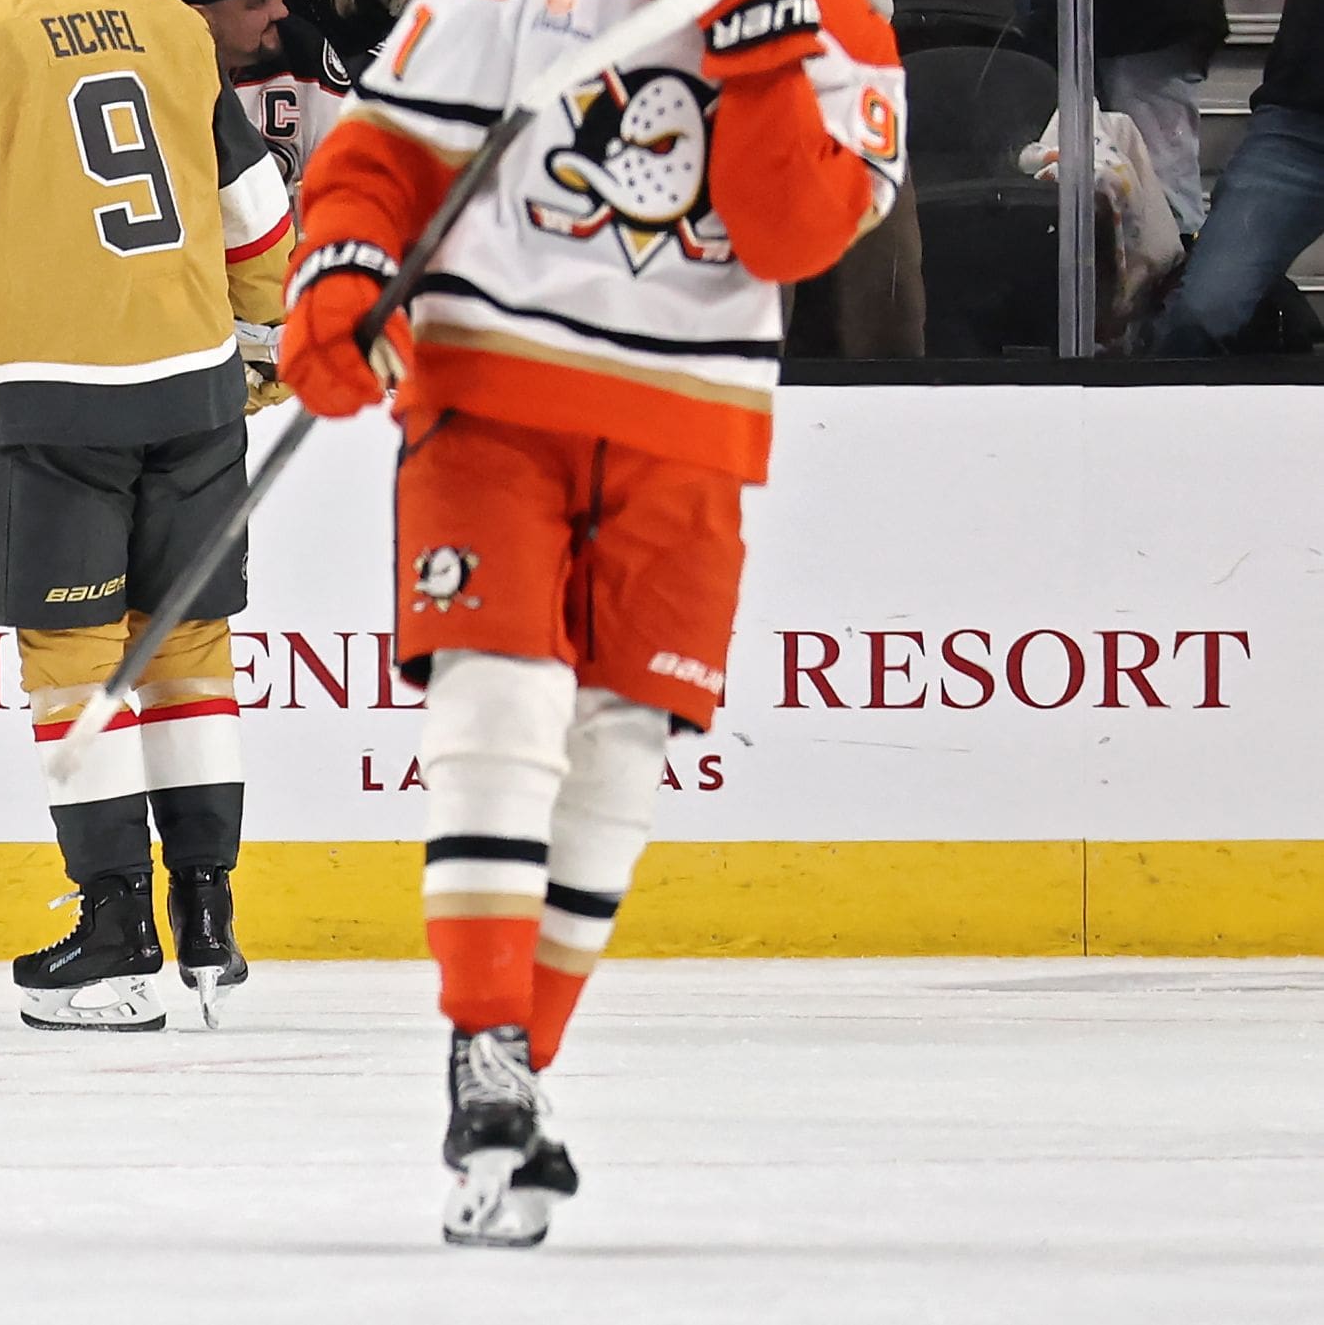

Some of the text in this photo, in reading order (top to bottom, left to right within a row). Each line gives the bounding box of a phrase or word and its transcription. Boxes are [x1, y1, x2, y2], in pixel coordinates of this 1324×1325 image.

[41, 9, 146, 59] EICHEL
[260, 84, 301, 141] C
[68, 70, 186, 258] 9
[774, 630, 1251, 709] RESORT
[361, 754, 429, 792] LA
